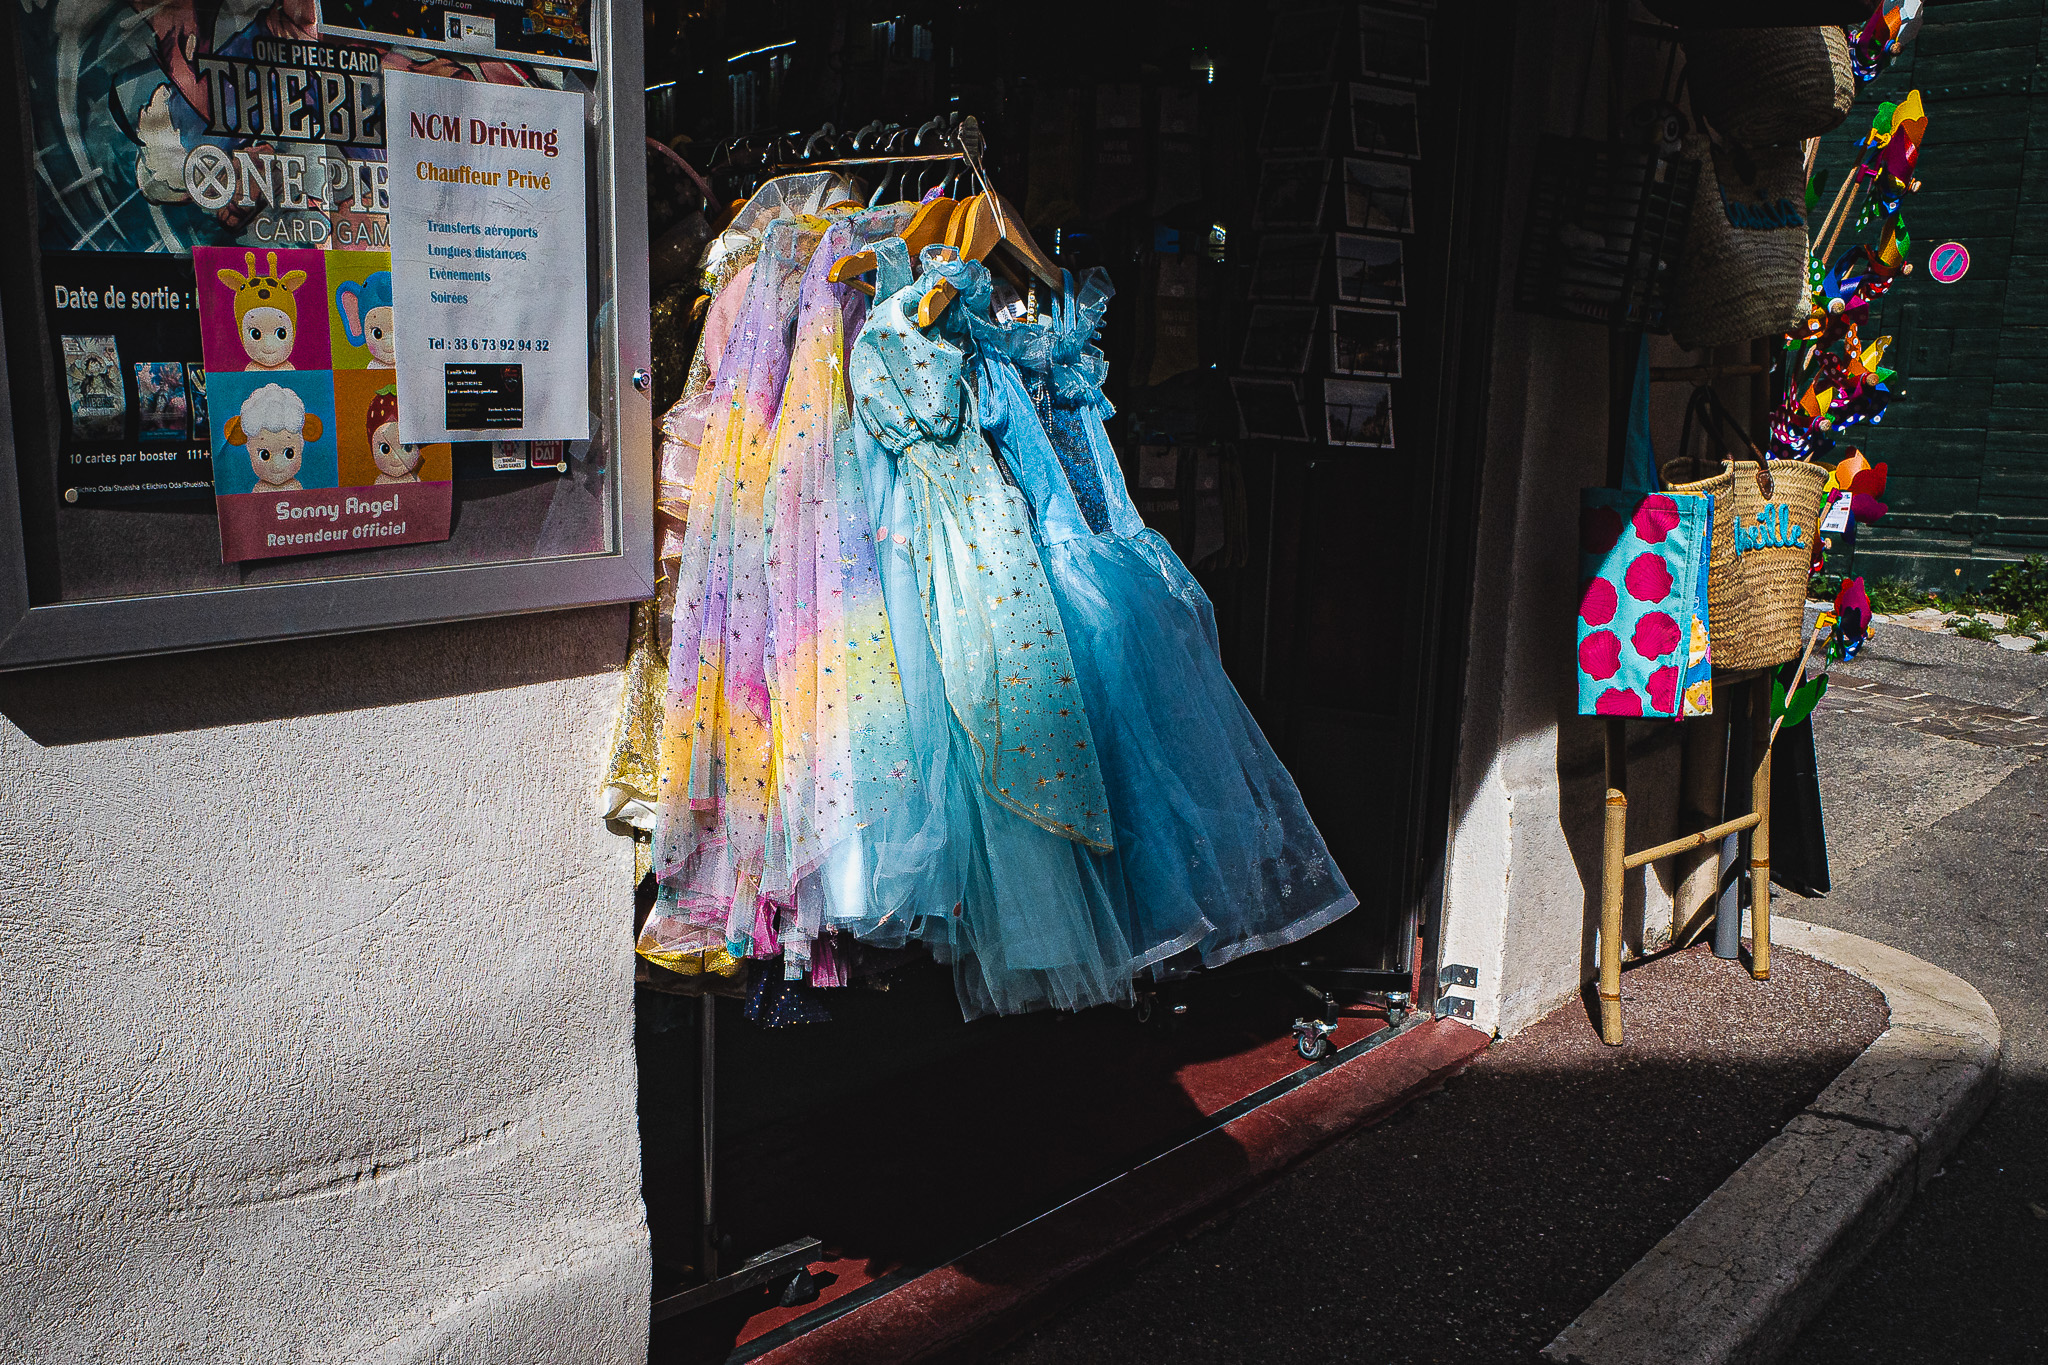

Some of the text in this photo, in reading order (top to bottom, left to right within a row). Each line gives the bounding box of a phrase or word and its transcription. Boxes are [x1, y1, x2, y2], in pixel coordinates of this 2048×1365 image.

[256, 40, 379, 73] ONE PIECE CARD
[198, 58, 311, 139] THE
[410, 111, 559, 158] NCM Driving
[184, 143, 307, 209] ONE
[416, 161, 551, 191] Chauffeur Privé
[255, 217, 327, 242] CARD
[427, 219, 539, 239] Transferts aéroports
[427, 243, 527, 261] Longues distances
[54, 285, 99, 309] Date
[103, 285, 126, 309] de
[131, 286, 180, 310] sortie
[430, 291, 468, 304] Soirées
[428, 337, 445, 350] Tel
[454, 338, 468, 350] 33
[471, 338, 479, 350] 6
[481, 339, 496, 350] 73
[500, 339, 515, 351] 92
[518, 339, 532, 351] 94
[535, 340, 549, 351] 32
[69, 449, 212, 465] 10 cartes par booster 111+
[276, 493, 399, 522] Sonny Angel
[267, 521, 406, 547] Revendeur Officiel
